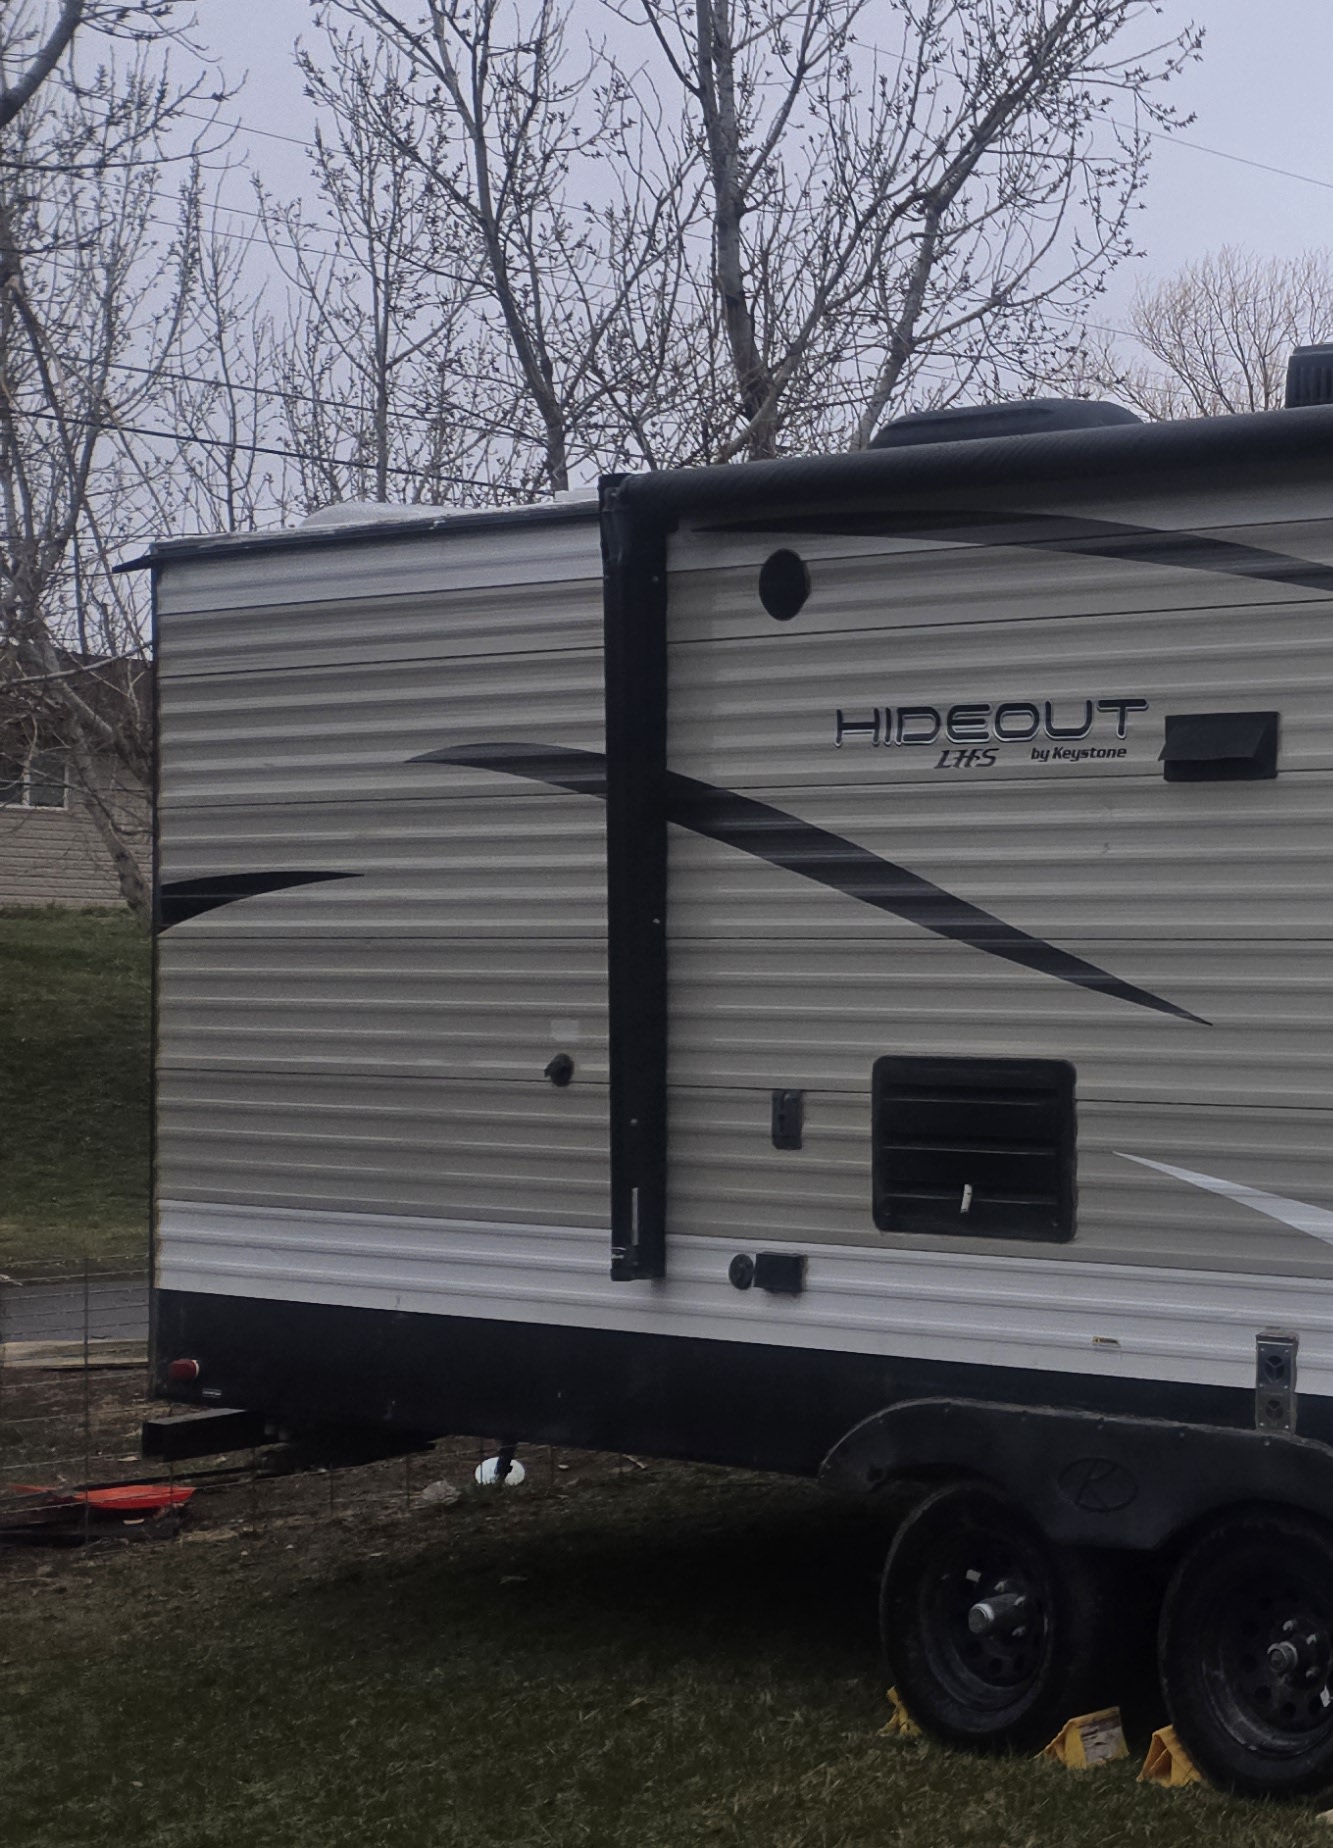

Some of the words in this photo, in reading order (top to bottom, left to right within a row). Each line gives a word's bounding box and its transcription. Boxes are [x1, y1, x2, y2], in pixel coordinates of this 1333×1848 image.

[834, 698, 1149, 747] HIDEOUT
[1031, 747, 1050, 762] by
[1052, 745, 1127, 761] Keystone
